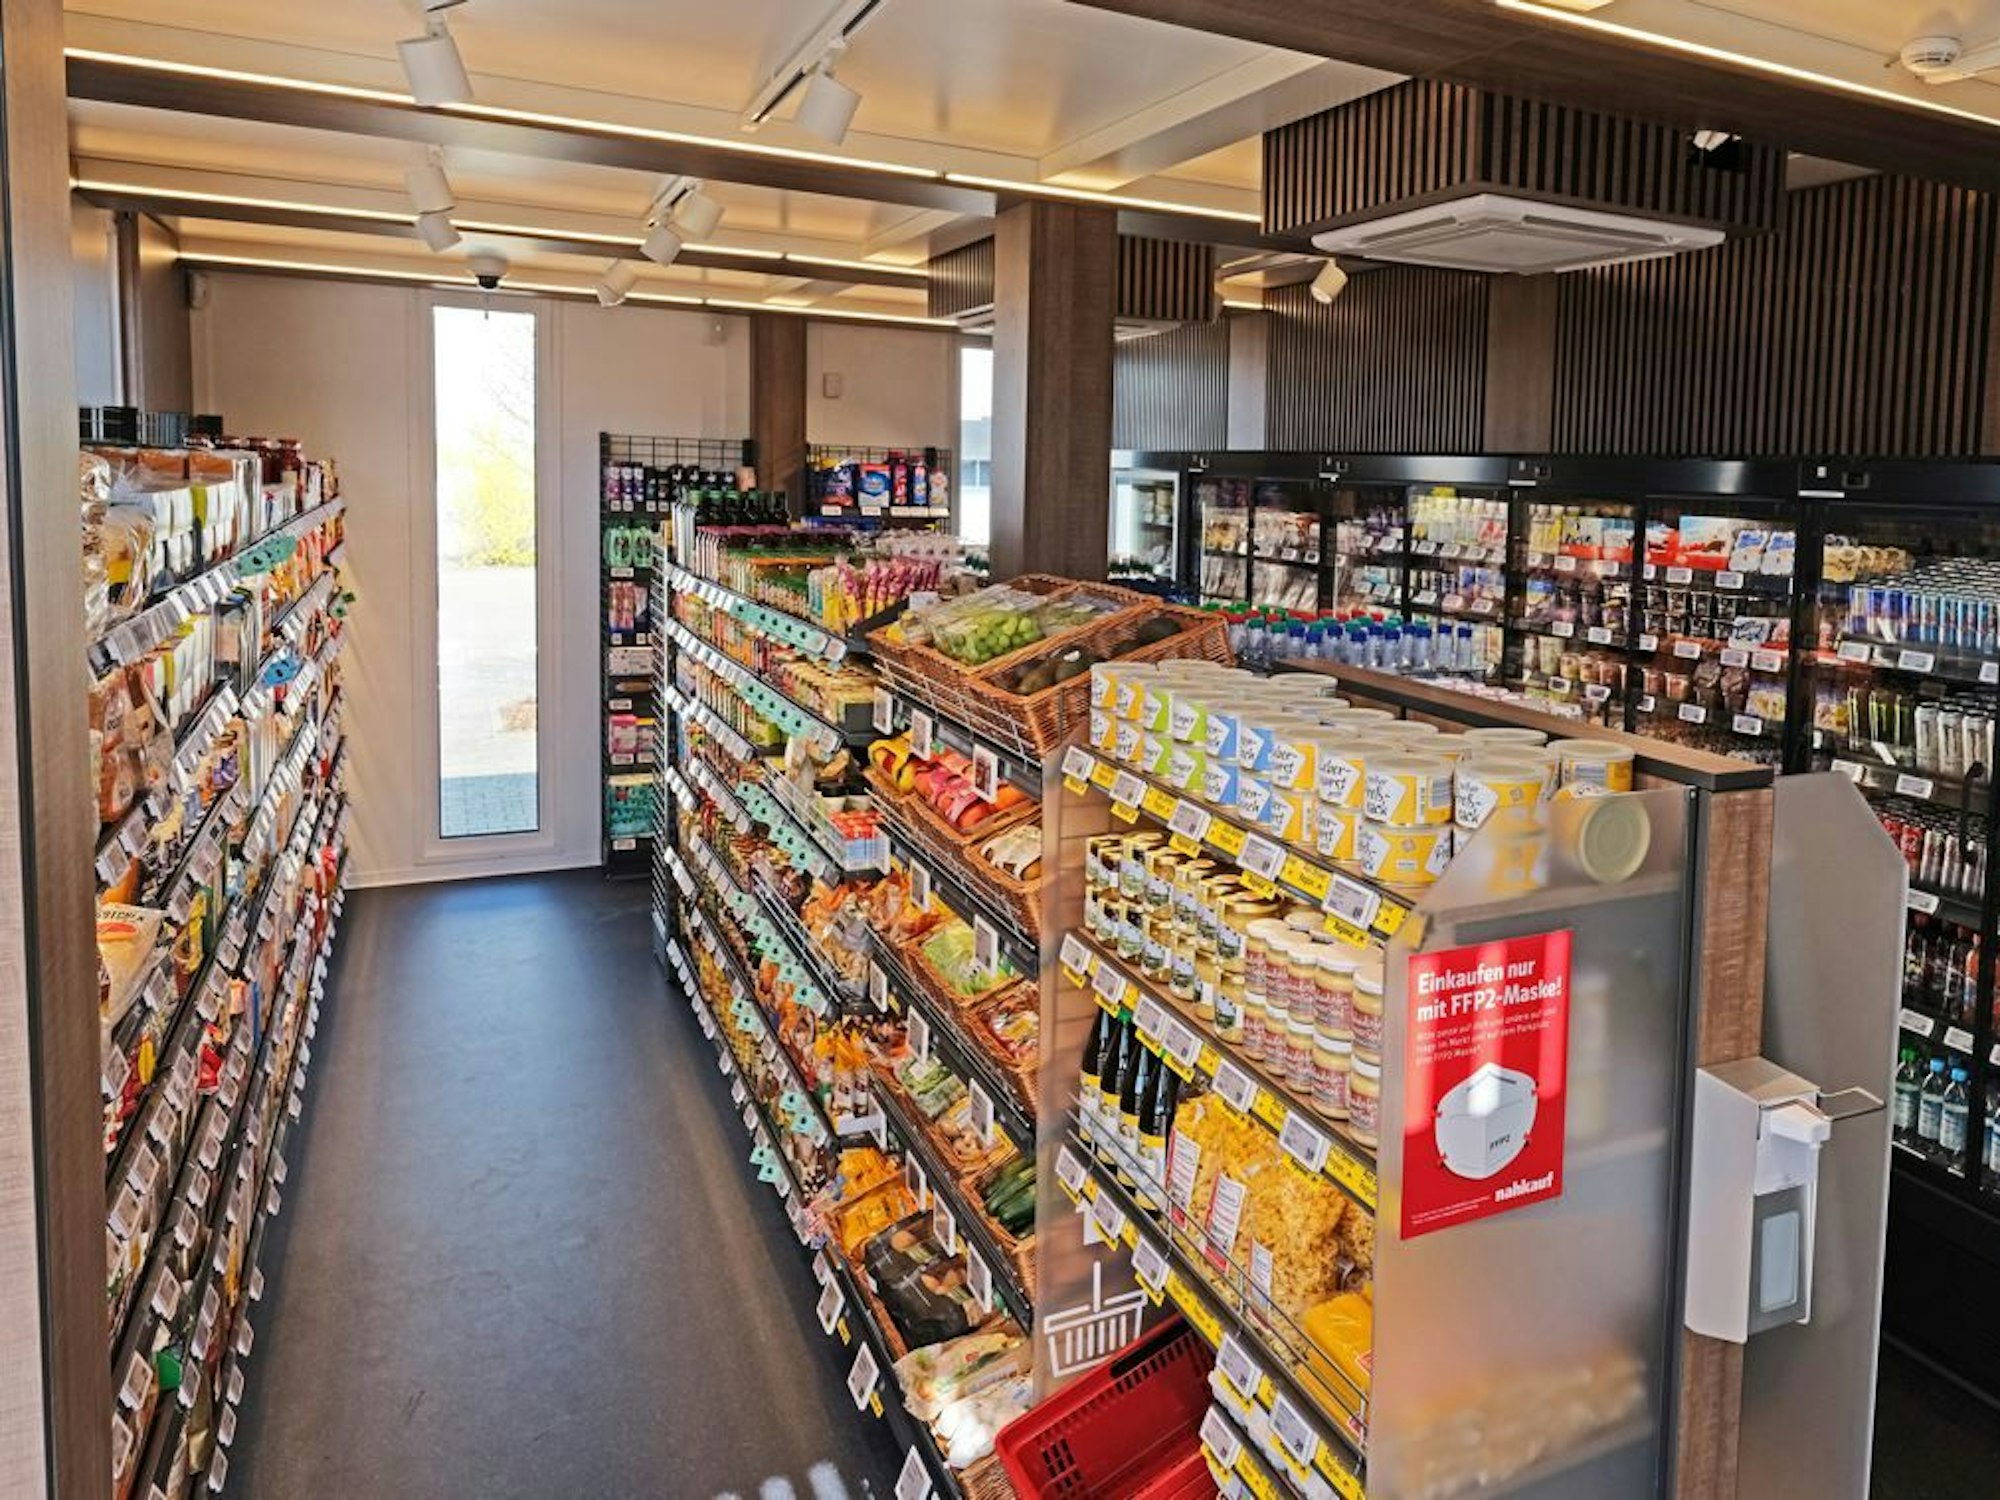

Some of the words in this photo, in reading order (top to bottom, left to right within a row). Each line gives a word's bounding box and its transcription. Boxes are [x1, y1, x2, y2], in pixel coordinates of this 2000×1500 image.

[1418, 963, 1504, 995] Einkaufen
[1507, 960, 1536, 979] nur
[1417, 998, 1448, 1024] mit
[1451, 976, 1562, 1016] FFP2-Maske!
[1494, 1171, 1555, 1203] nahkauf
